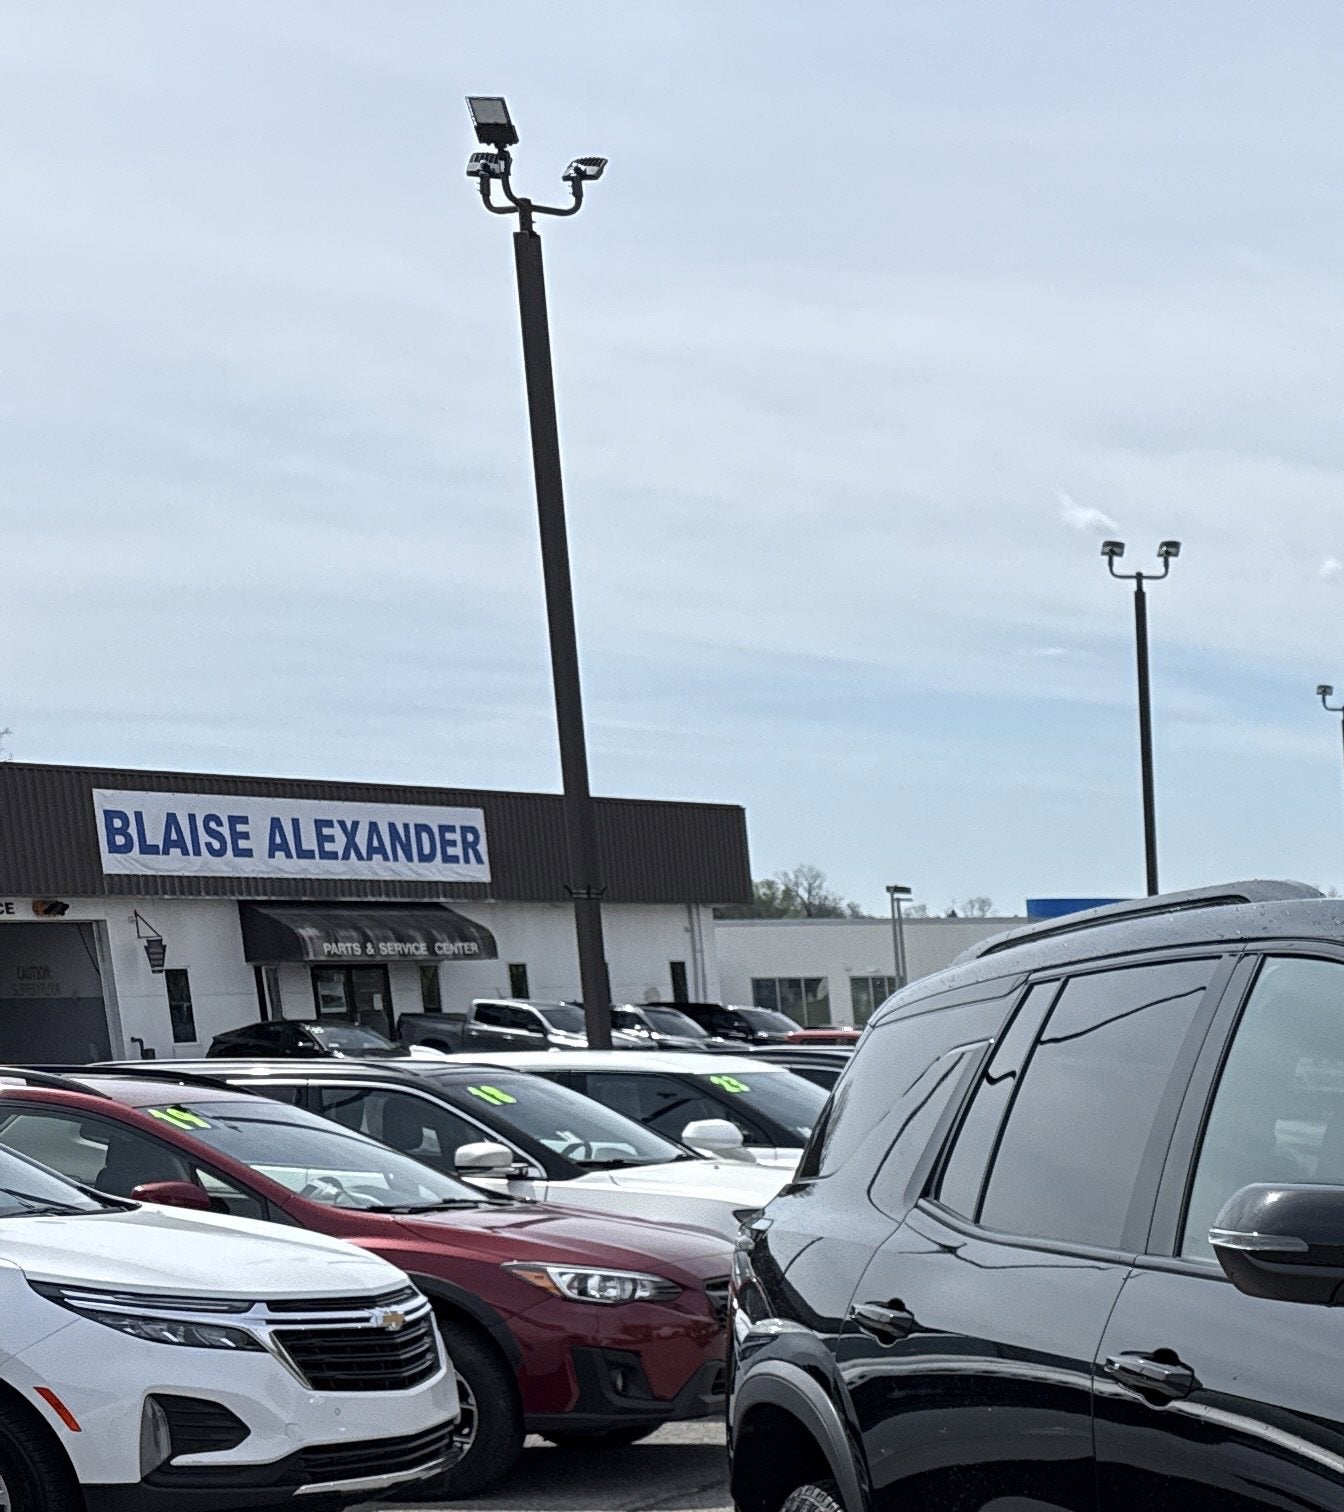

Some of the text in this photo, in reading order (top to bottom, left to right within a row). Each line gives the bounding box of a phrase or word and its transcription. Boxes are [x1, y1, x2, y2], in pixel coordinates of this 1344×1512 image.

[102, 809, 484, 865] BLAISE ALEXANDER
[323, 941, 479, 956] PARTS & SERVICE CENTER
